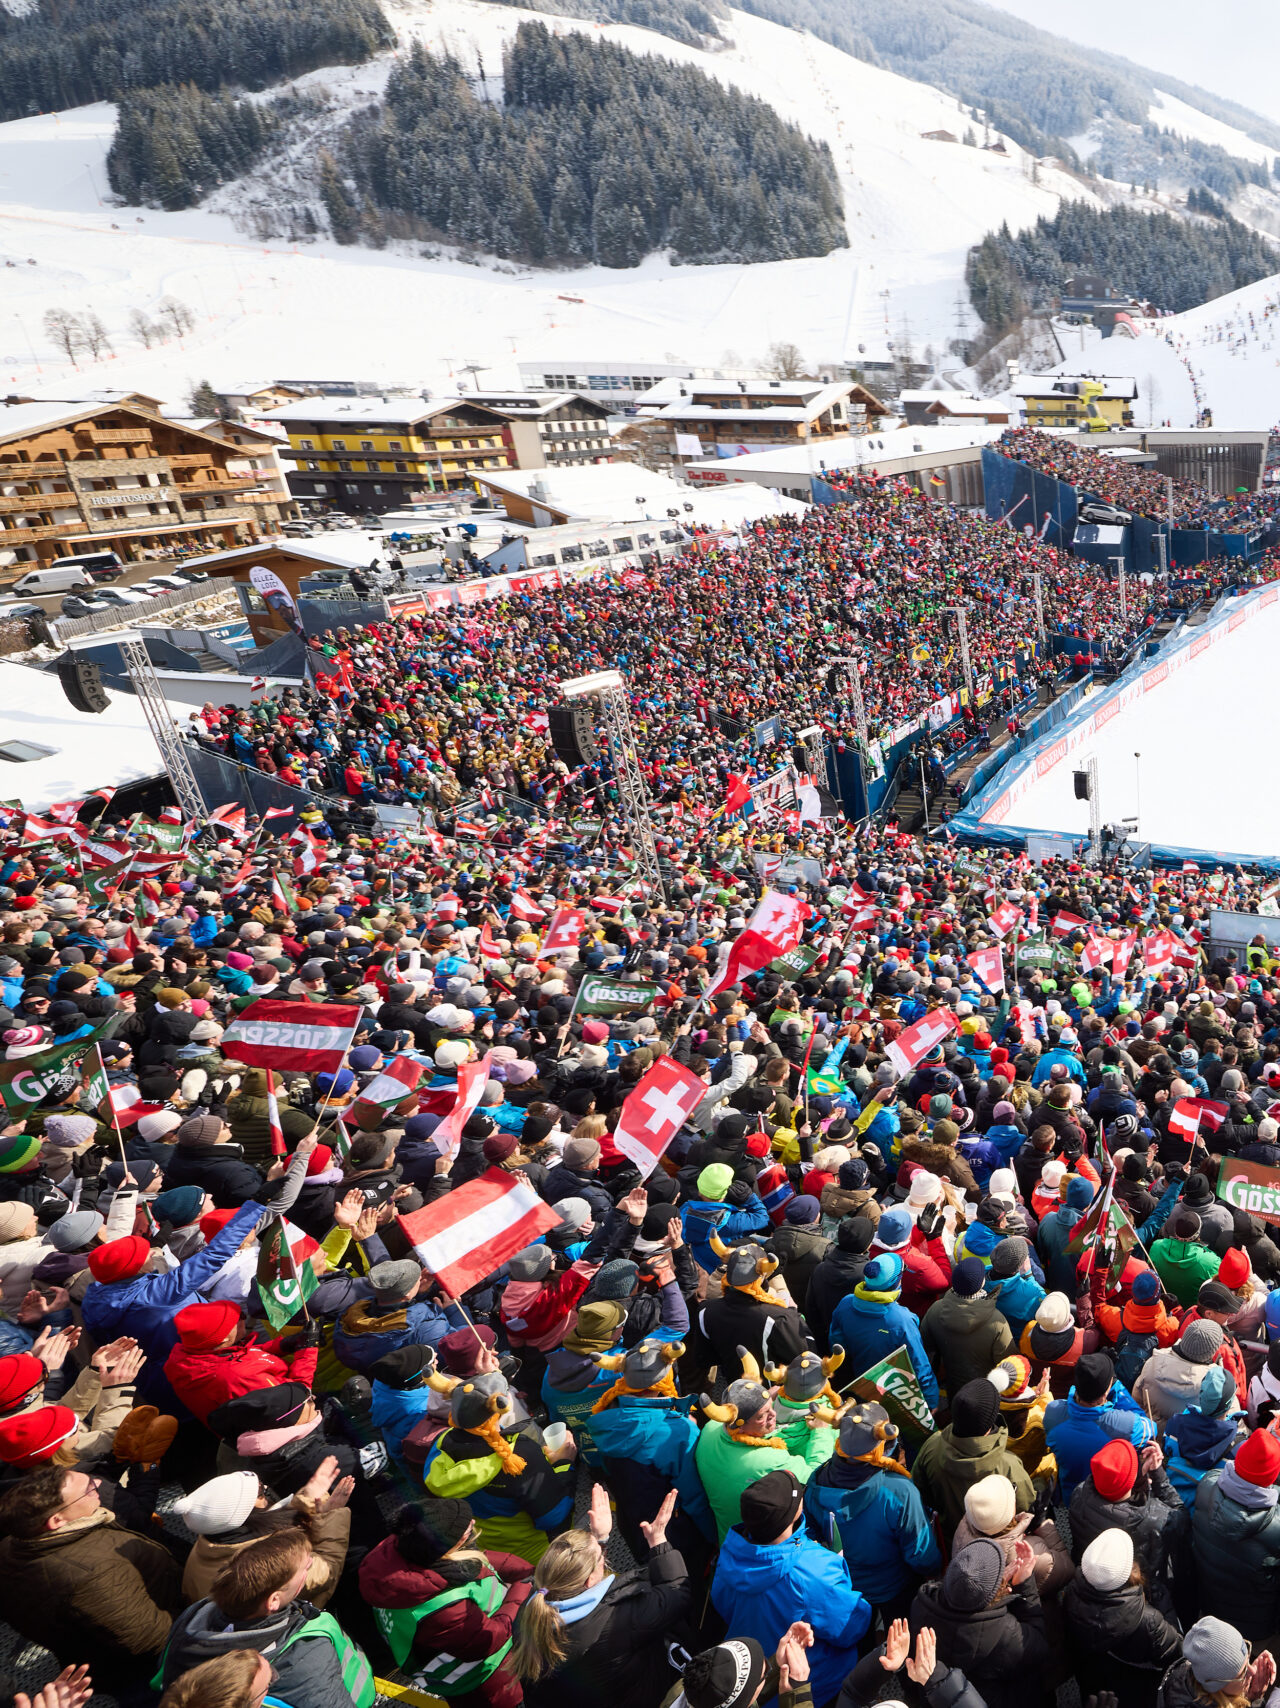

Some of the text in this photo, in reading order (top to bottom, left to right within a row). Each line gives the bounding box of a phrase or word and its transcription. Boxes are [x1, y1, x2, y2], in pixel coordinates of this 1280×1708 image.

[92, 494, 156, 505] HUBERTUSHOF
[253, 574, 274, 583] ALLEZ
[1038, 741, 1068, 776] GENERALI
[583, 980, 651, 1004] Gösser
